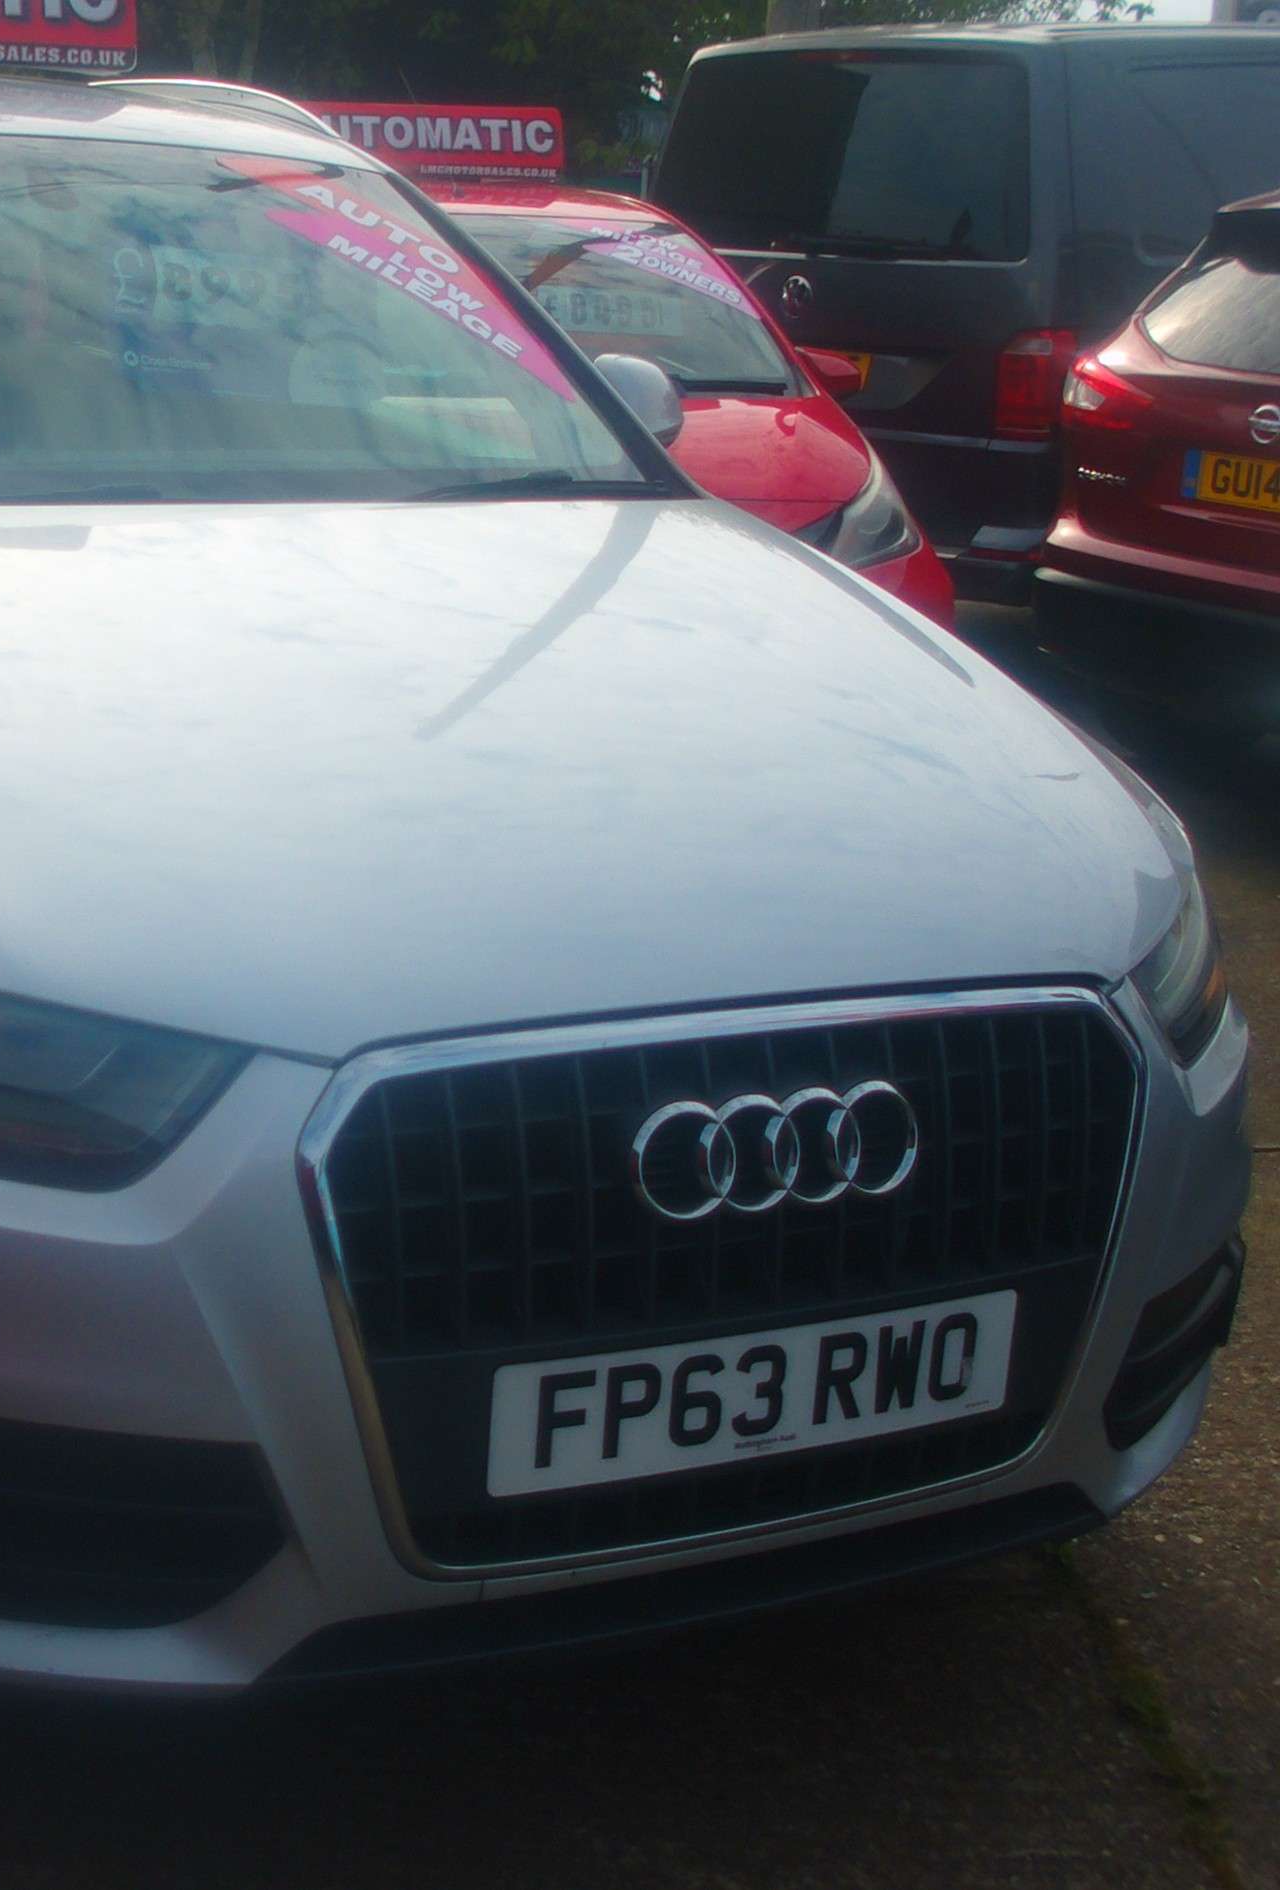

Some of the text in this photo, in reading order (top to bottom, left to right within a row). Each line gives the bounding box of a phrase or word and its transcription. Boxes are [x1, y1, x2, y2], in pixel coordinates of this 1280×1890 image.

[321, 114, 554, 153] UTOMATIC
[295, 185, 459, 274] AUTO
[327, 234, 523, 359] MILEAGE
[389, 250, 485, 311] LOW
[610, 243, 741, 304] 2 OWNERS
[534, 1312, 978, 1469] FP63 RWO
